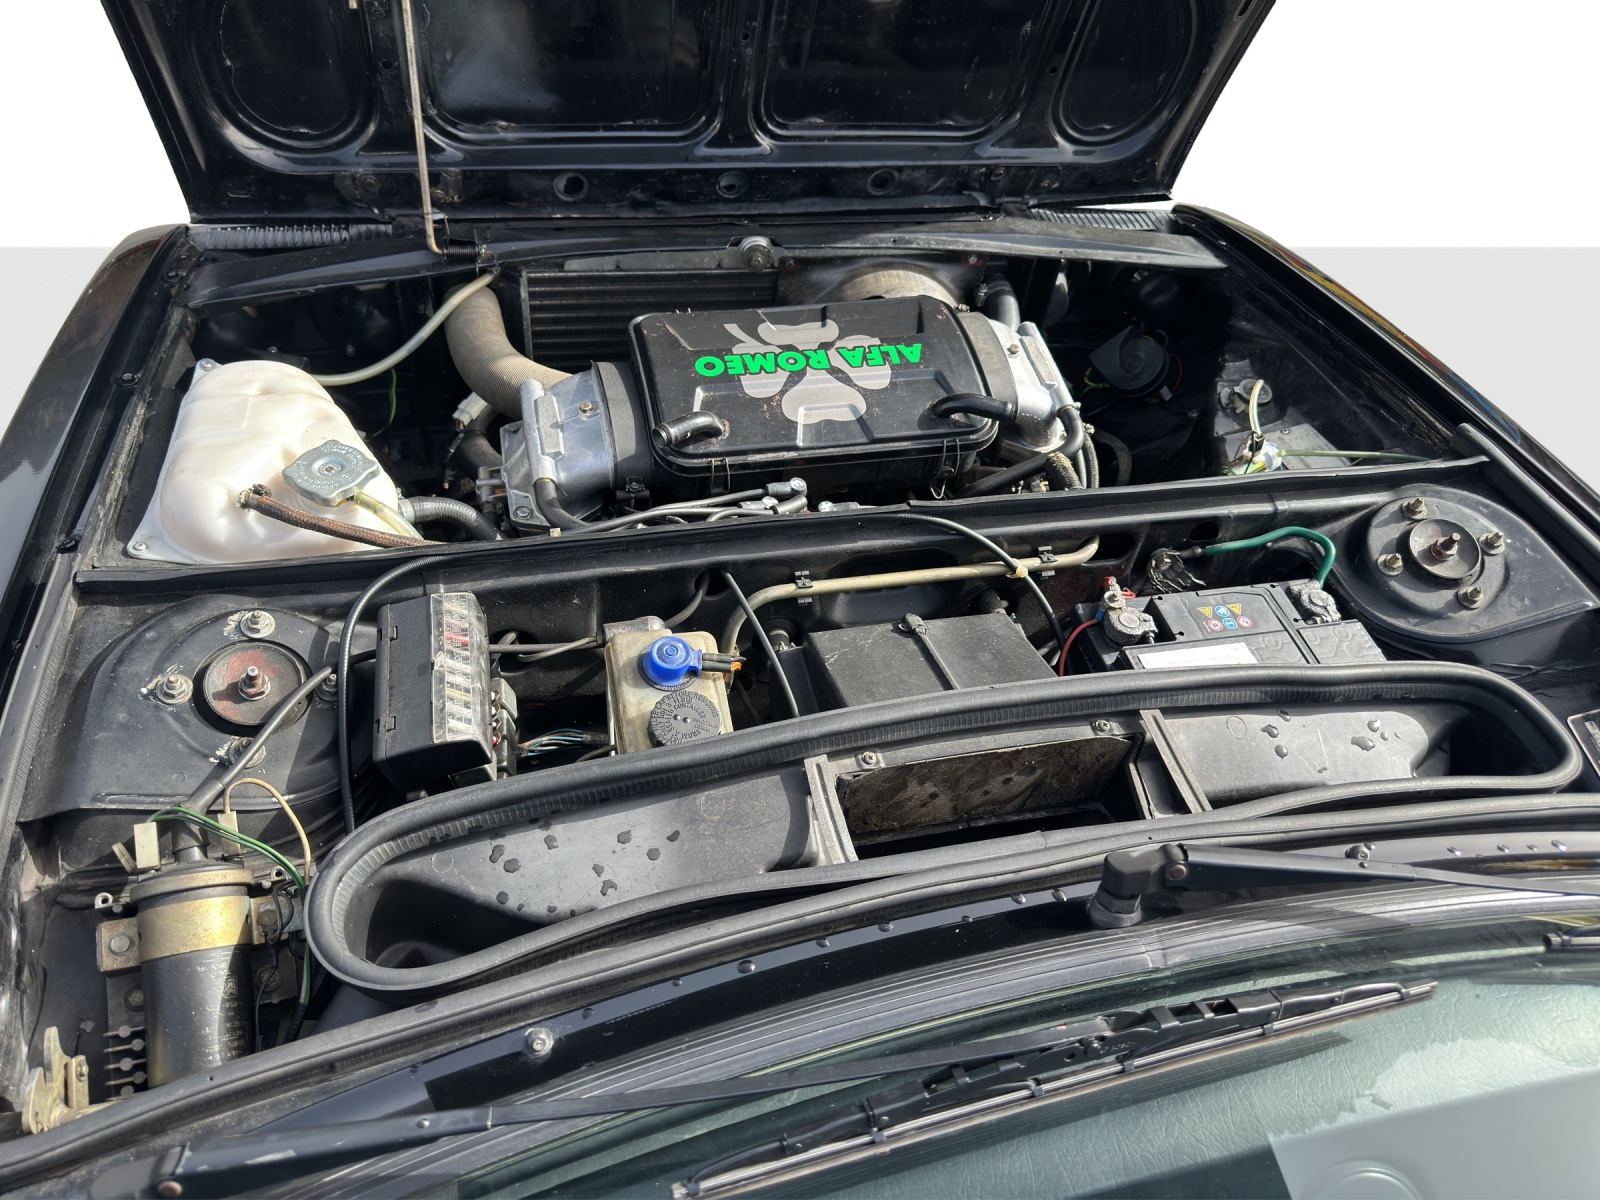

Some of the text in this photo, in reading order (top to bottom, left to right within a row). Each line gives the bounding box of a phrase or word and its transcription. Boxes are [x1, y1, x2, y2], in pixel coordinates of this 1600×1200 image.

[694, 343, 922, 377] ALFA ROMEO
[651, 710, 659, 731] FILLER
[655, 697, 666, 709] CAP
[665, 690, 691, 700] BEFORE
[658, 706, 667, 718] DOT
